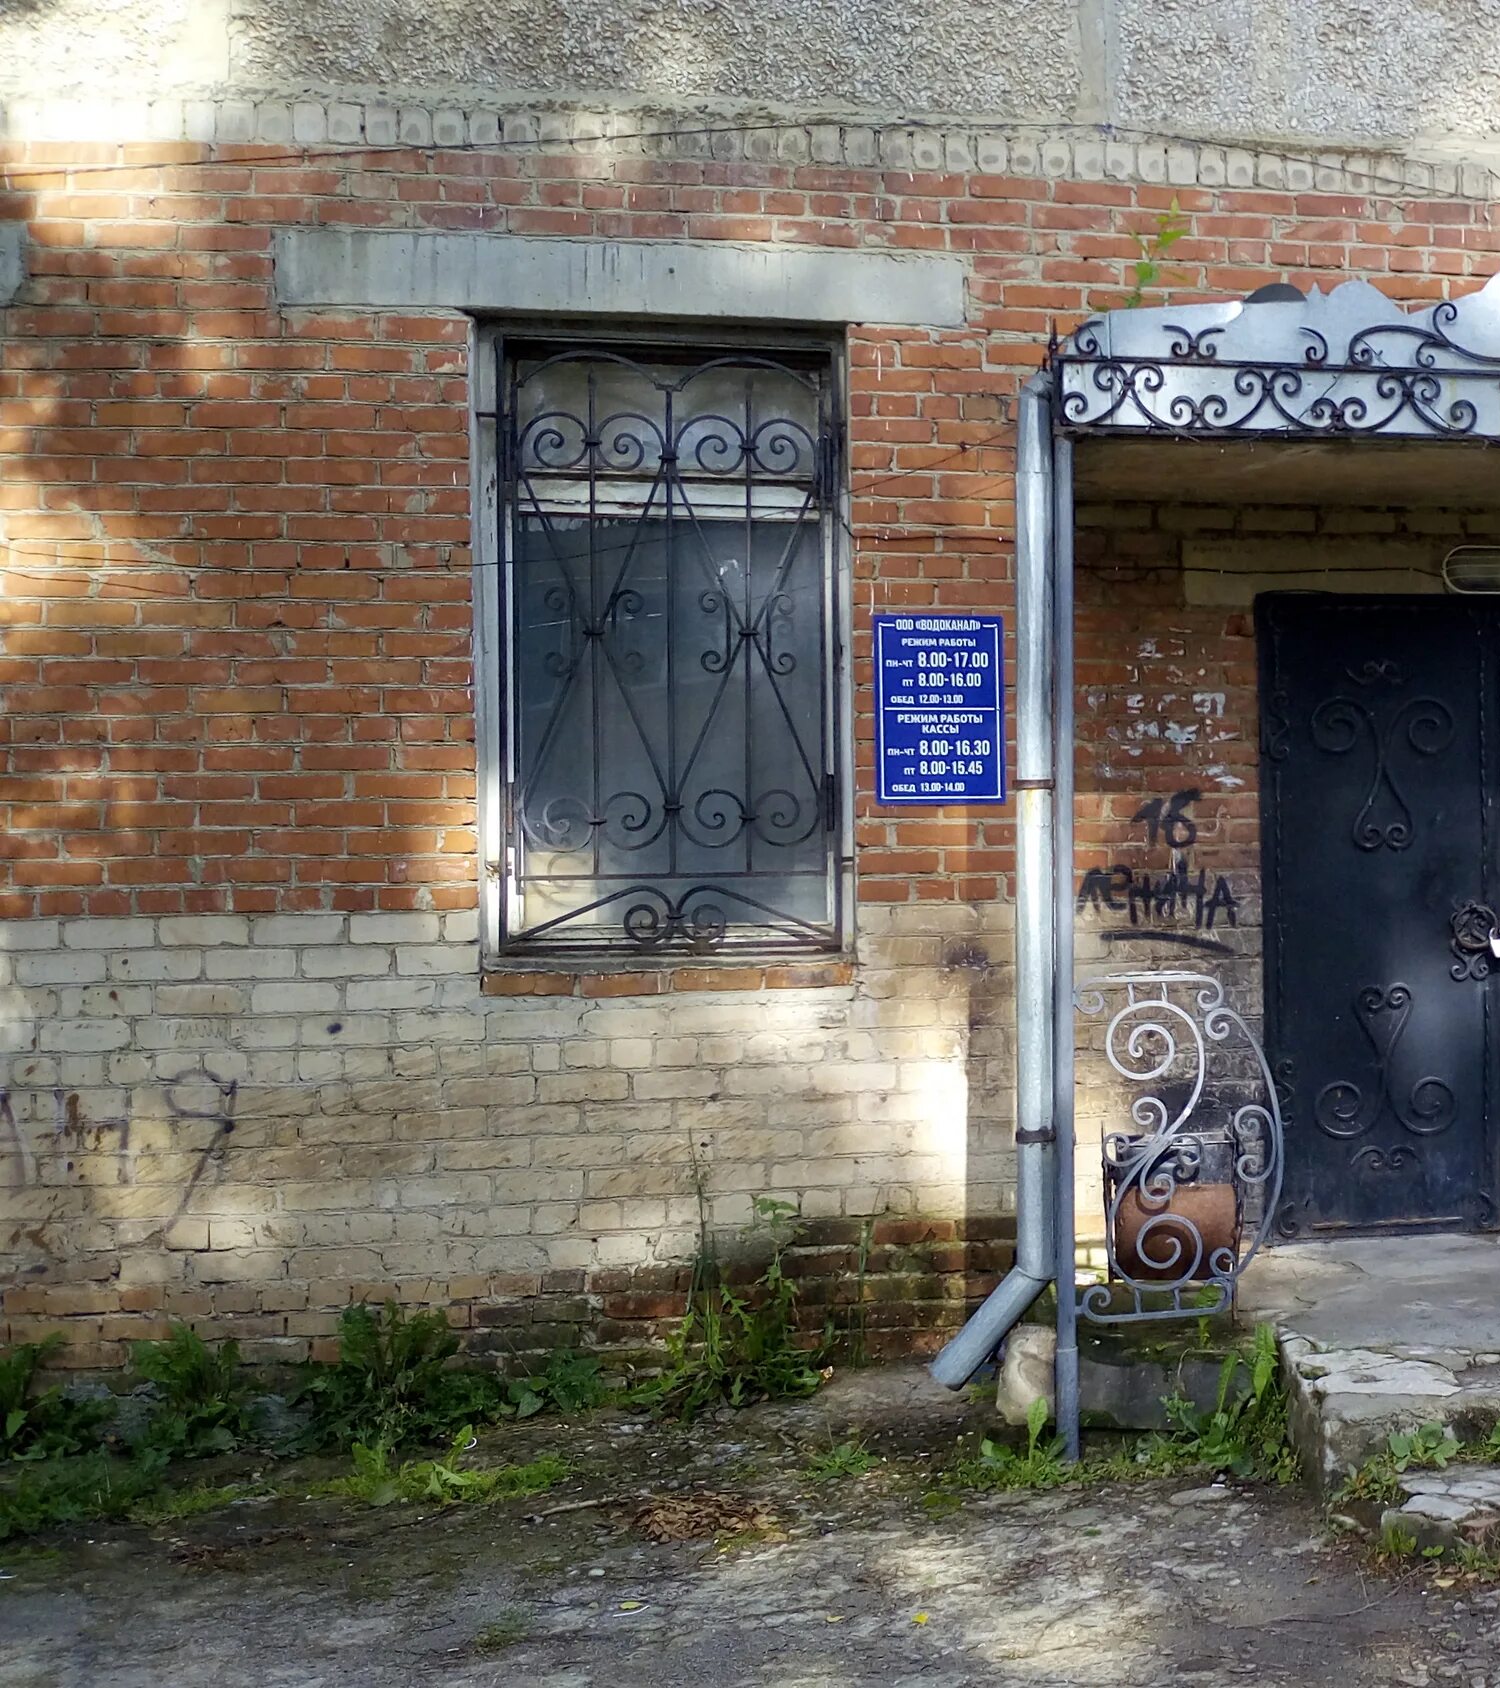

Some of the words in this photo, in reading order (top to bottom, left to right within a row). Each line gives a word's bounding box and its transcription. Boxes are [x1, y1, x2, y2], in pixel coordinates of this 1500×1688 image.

[896, 619, 913, 631] ООО
[916, 619, 981, 632] «ВОДОКАНАЛ»
[902, 638, 937, 647] РЕЖИМ
[939, 638, 976, 647] РАБОТЫ
[918, 652, 989, 668] 8.00-17.00
[918, 673, 981, 686] 8.00-16.00
[891, 696, 914, 704] ОБЕД
[919, 695, 963, 704] 12.00-13.00
[897, 715, 938, 723] РЕЖИМ
[940, 715, 983, 723] РАБОТЫ
[922, 725, 959, 733] КАССЫ
[919, 740, 990, 755] 8.00-16.30
[920, 761, 983, 775] 8.00-15.45
[892, 784, 916, 792] ОБЕД
[921, 783, 965, 792] 13.00-14.00
